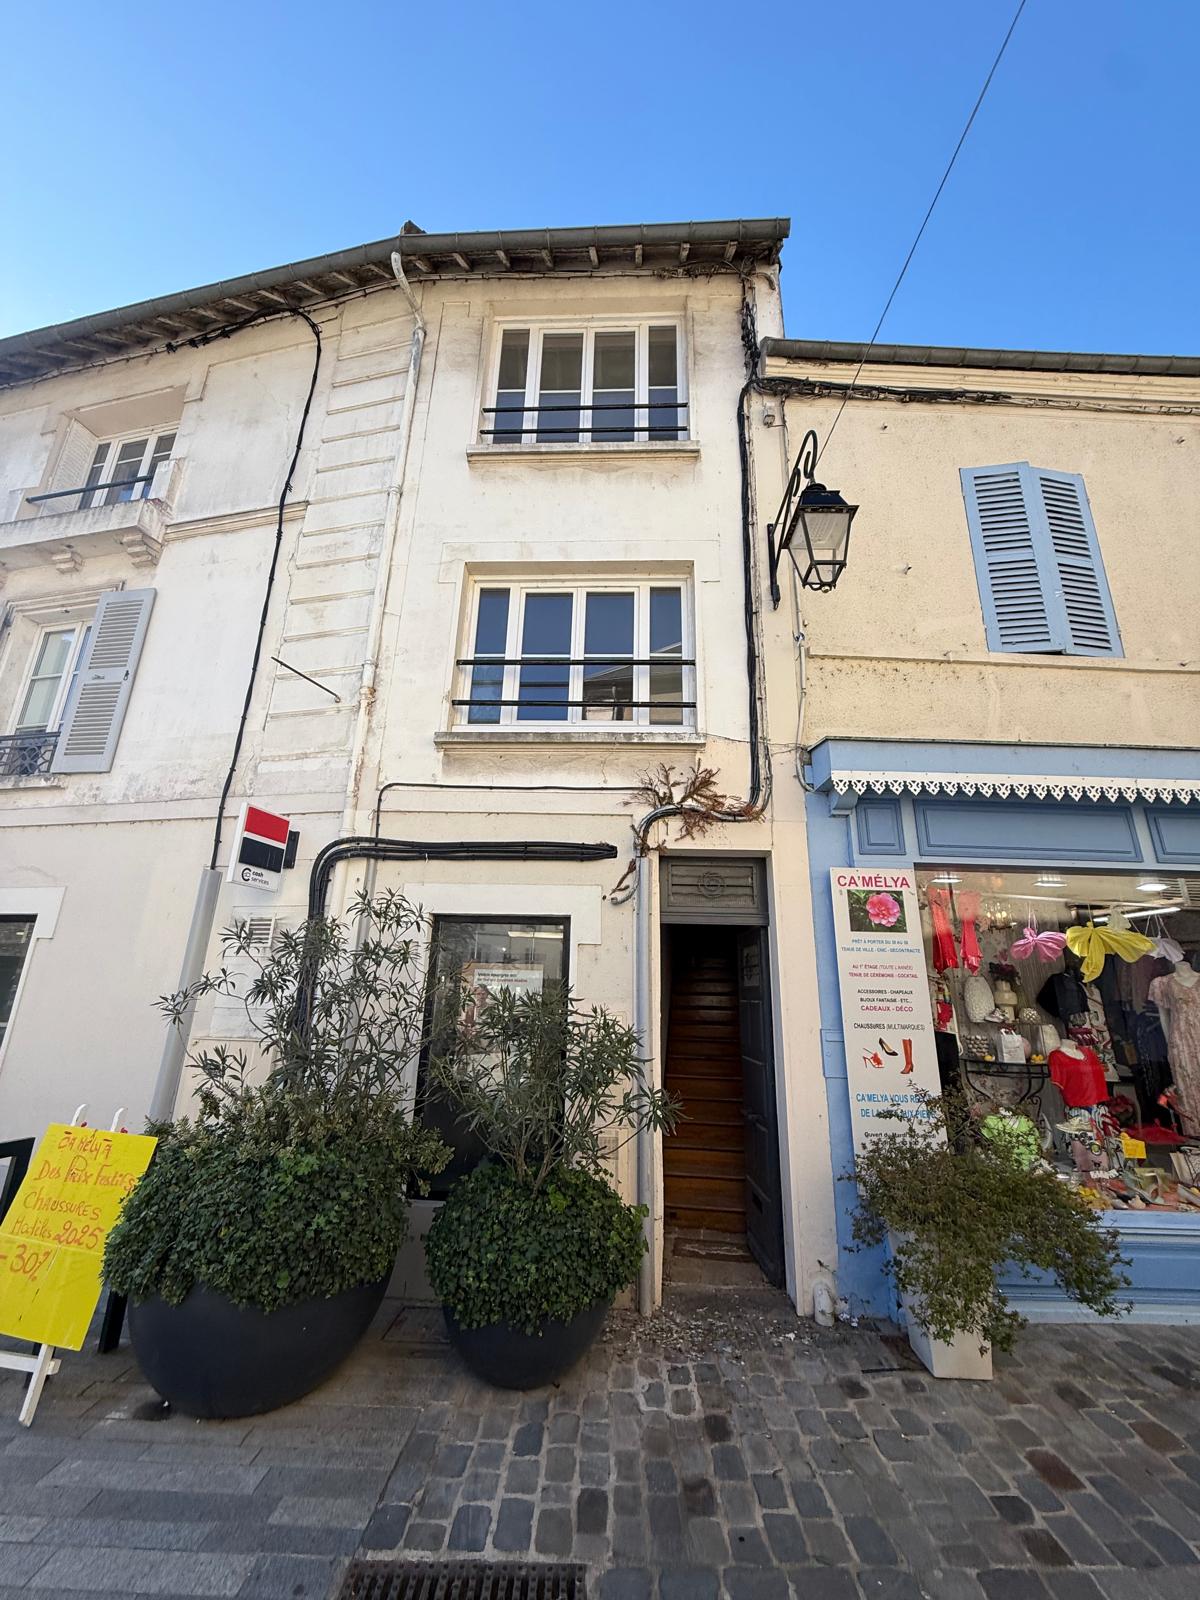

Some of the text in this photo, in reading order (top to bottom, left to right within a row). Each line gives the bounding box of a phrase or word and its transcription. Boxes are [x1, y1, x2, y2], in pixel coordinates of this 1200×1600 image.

[251, 877, 269, 885] services
[837, 874, 910, 888] CA'MÉLYA
[860, 1109, 870, 1118] DE
[34, 1160, 61, 1180] Des
[64, 1155, 94, 1184] Prix
[52, 1220, 104, 1250] 2025
